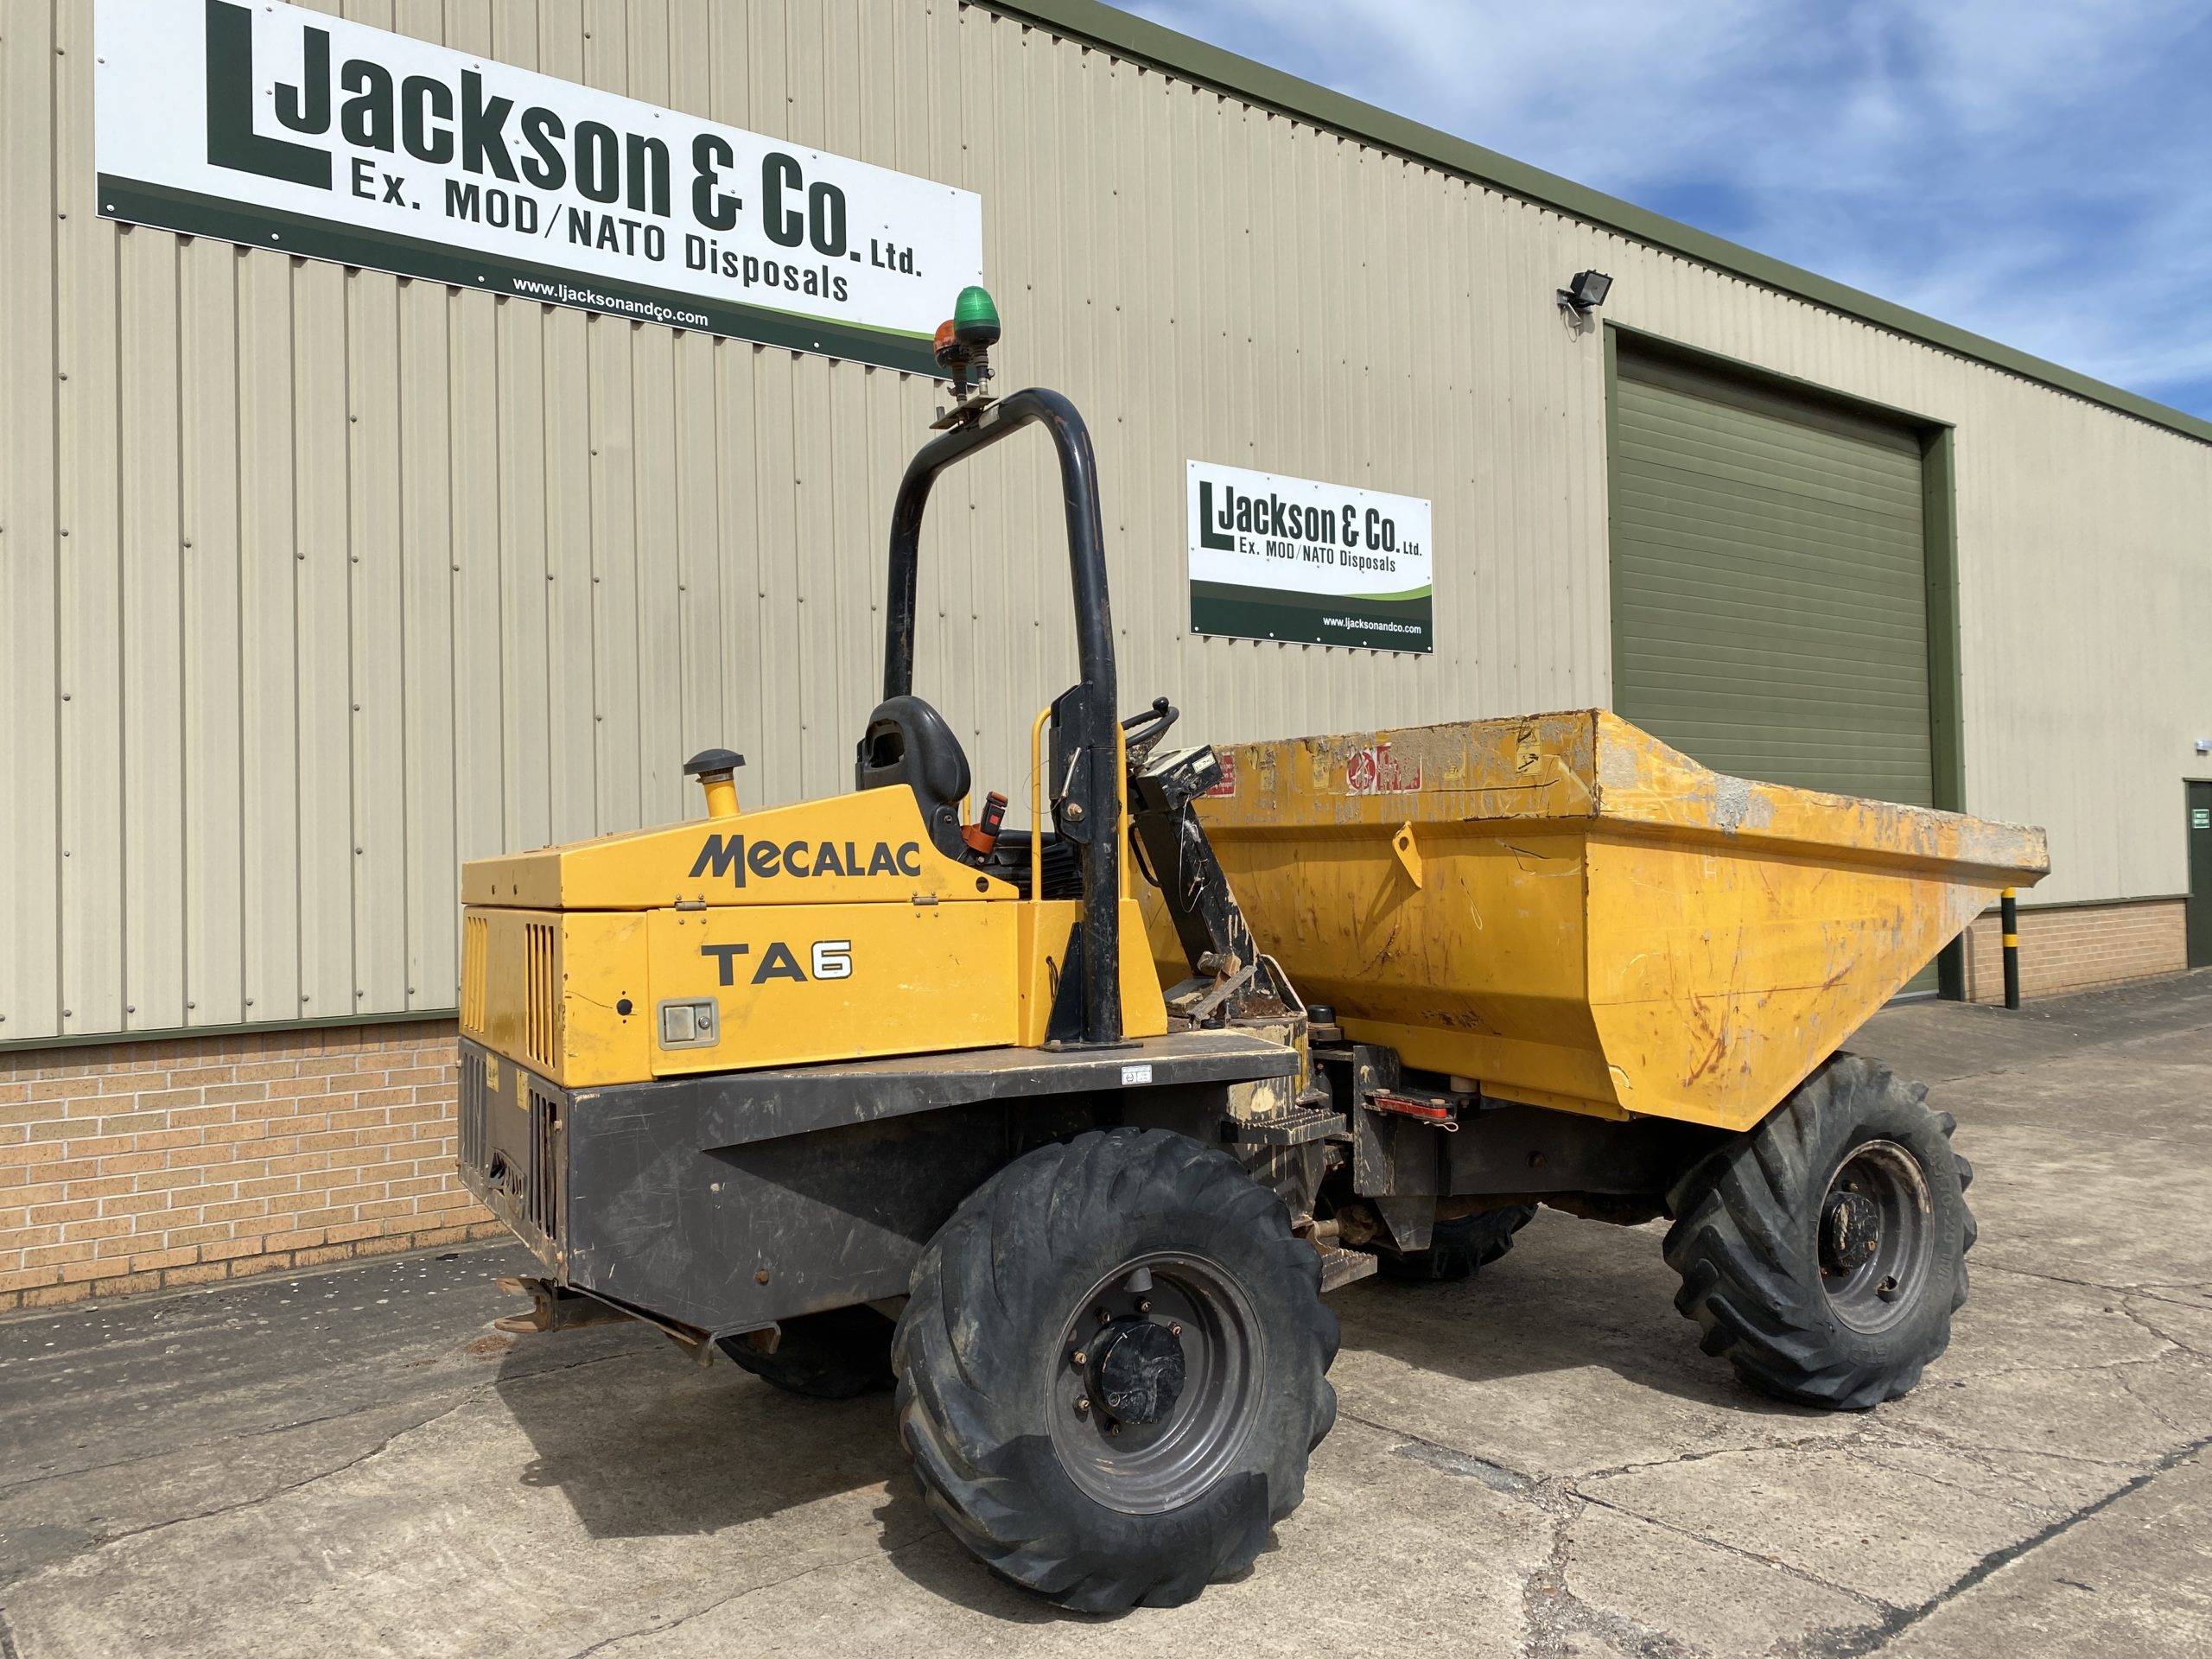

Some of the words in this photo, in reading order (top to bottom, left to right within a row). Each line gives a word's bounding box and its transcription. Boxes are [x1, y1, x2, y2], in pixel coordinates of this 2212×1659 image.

[351, 156, 421, 210] Ex.
[445, 178, 664, 262] MOD/NATO
[685, 233, 849, 302] Disposals
[692, 133, 742, 231] &
[762, 152, 861, 262] Co.
[870, 238, 922, 276] Ltd.
[512, 277, 709, 327] www.ljacksonandco.com
[1239, 536, 1260, 555] Ex.
[1266, 539, 1334, 564] MOD/NATO
[1340, 550, 1396, 572] Disposals
[1342, 504, 1359, 547] &
[1365, 507, 1401, 553] Co.
[1403, 541, 1422, 556] Ltd.
[1323, 616, 1421, 634] www.ljacksonandco.com
[701, 939, 854, 987] TA6
